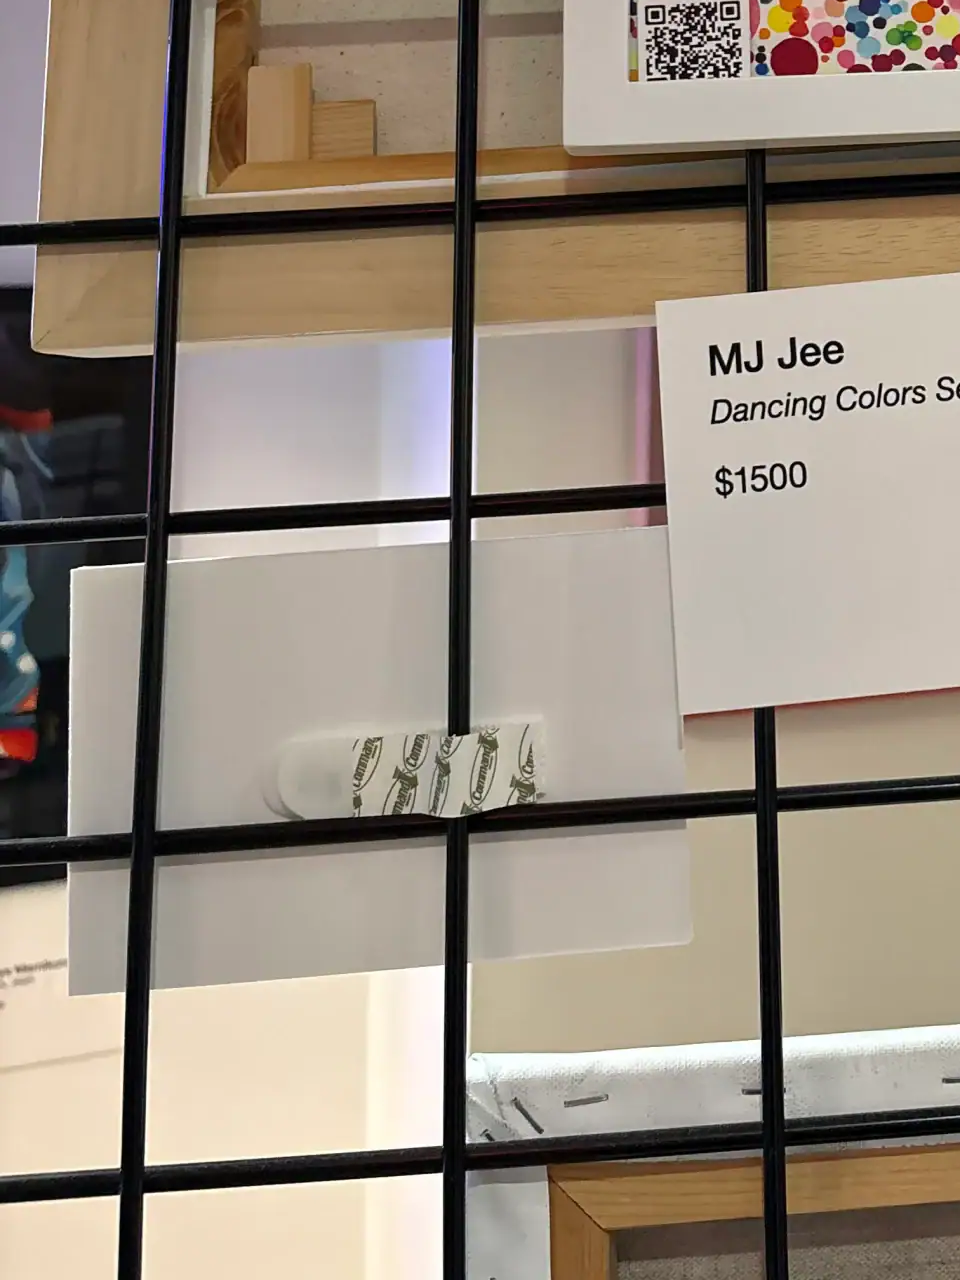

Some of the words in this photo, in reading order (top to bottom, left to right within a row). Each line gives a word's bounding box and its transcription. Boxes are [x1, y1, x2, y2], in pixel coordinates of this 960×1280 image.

[708, 340, 764, 376] MJ
[777, 336, 845, 370] Jee
[710, 392, 827, 425] Dancing
[836, 382, 927, 412] Colors
[714, 460, 808, 499] $1500
